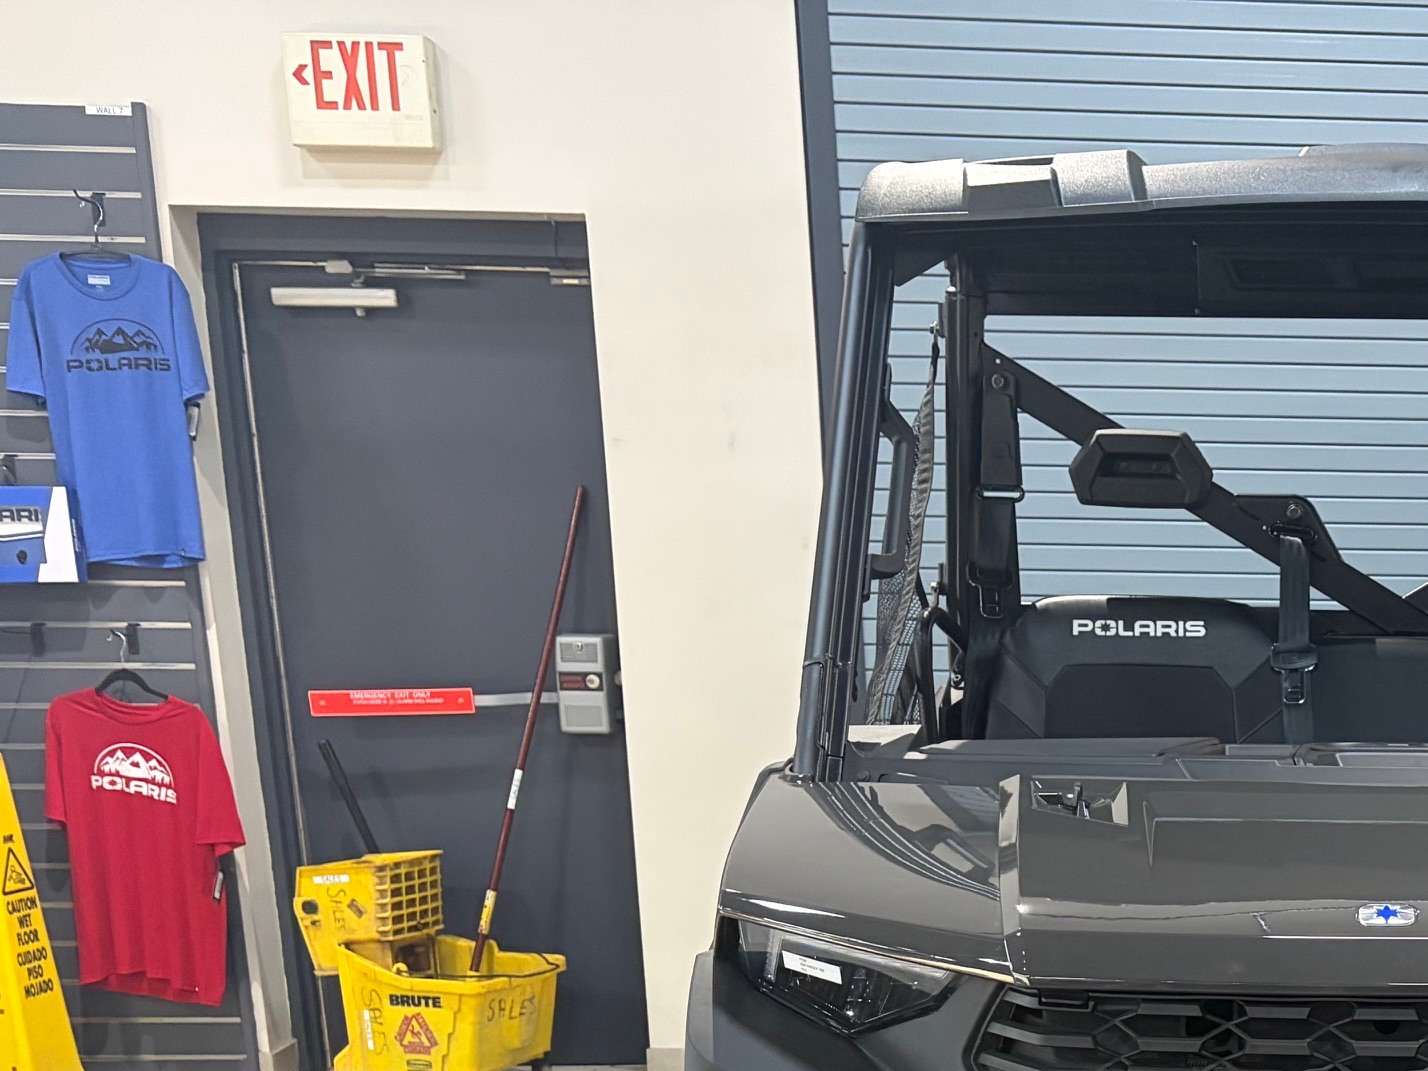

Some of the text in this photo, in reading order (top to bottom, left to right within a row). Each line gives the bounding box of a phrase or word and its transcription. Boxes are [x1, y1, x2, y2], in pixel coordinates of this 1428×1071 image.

[310, 40, 404, 112] EXIT
[95, 106, 117, 115] WALL
[66, 357, 172, 373] POLARIS
[1072, 618, 1207, 637] POLARIS
[90, 775, 177, 805] POLARIS
[6, 895, 38, 916] CAUTION
[17, 913, 33, 929] WET
[16, 928, 40, 946] FLOOR
[17, 946, 47, 967] CUIDADO
[27, 964, 44, 981] PISO
[24, 978, 54, 999] MOJADO
[389, 994, 442, 1009] BRUTE
[487, 995, 538, 1022] SALES
